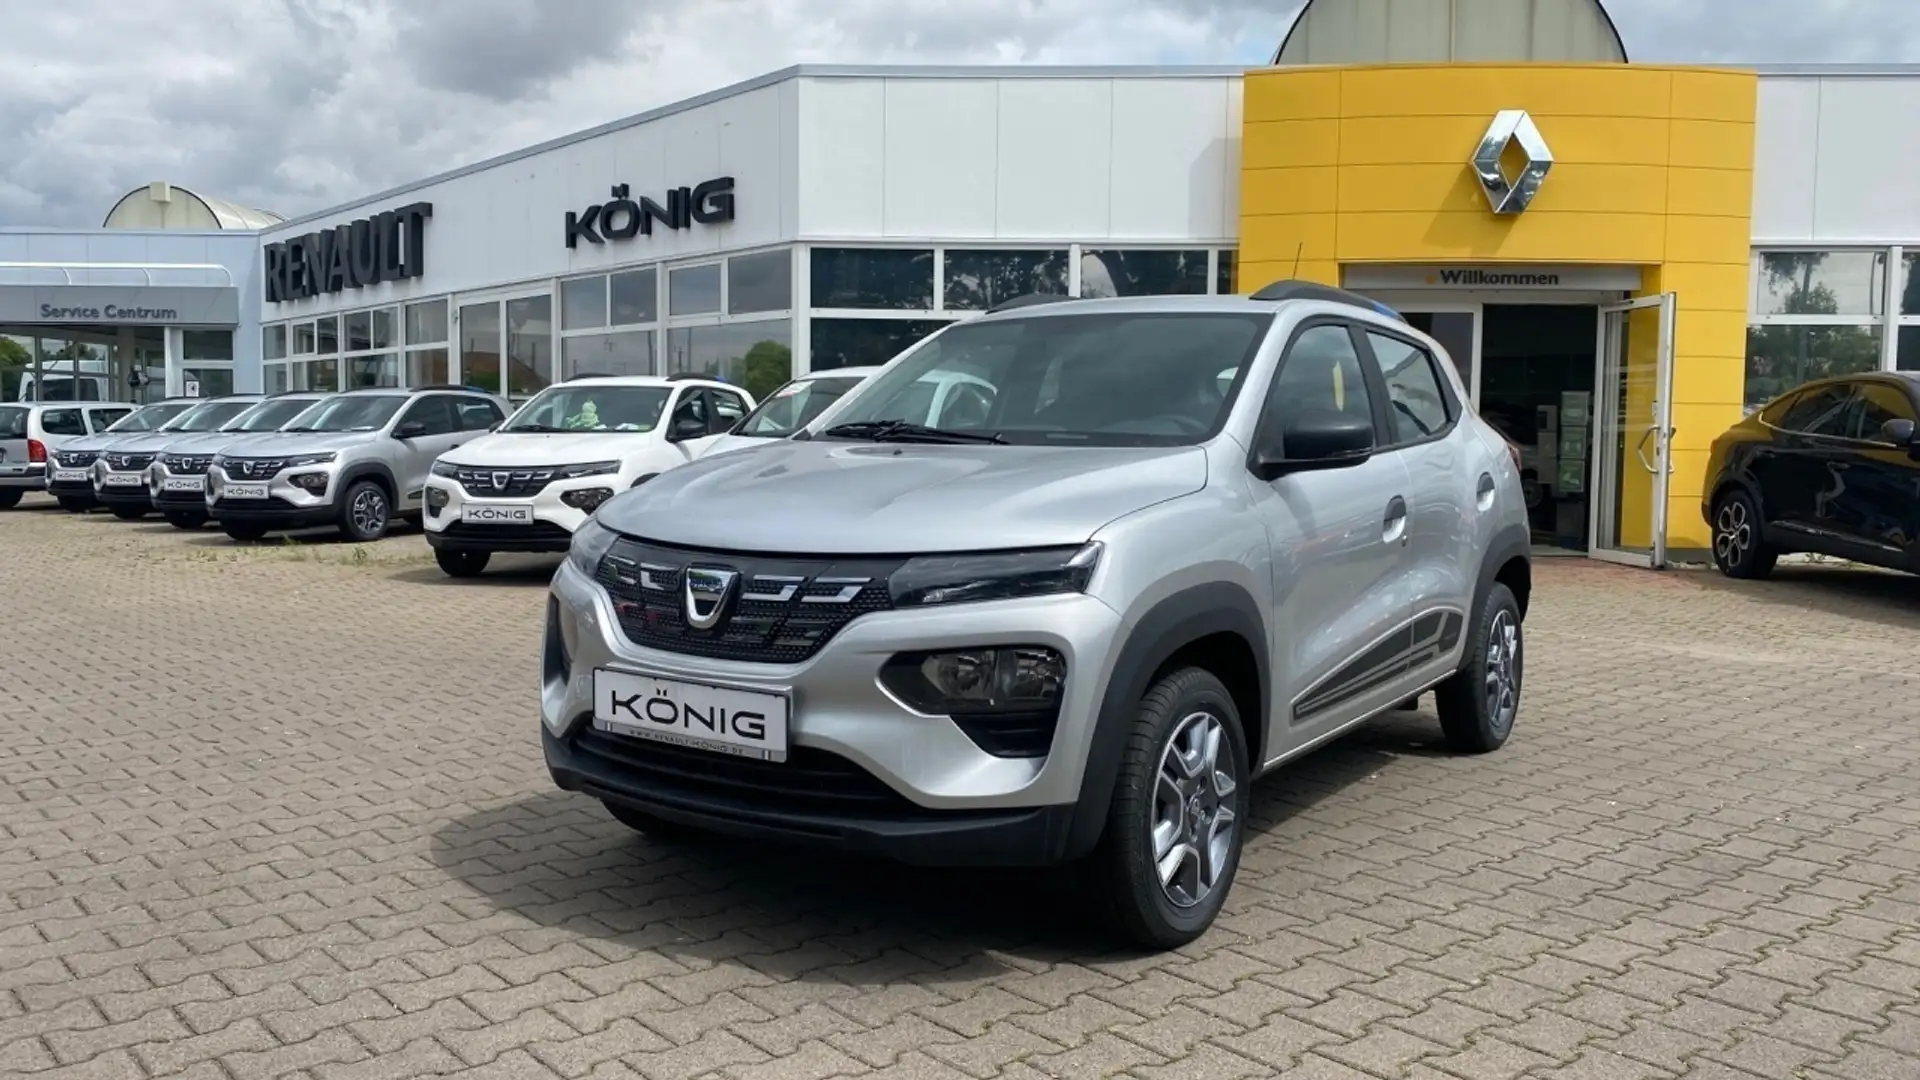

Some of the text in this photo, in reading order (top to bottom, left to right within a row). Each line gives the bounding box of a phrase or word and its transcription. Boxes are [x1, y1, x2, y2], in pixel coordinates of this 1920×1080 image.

[565, 176, 735, 249] KÖNIG
[264, 202, 433, 303] RENAULT
[1440, 269, 1559, 285] Willkommen
[41, 303, 177, 319] Service Centrum
[167, 480, 201, 489] KÖNIG
[226, 487, 265, 497] KÖNIG
[467, 507, 527, 520] KÖNIG
[611, 687, 766, 741] KÖNIG
